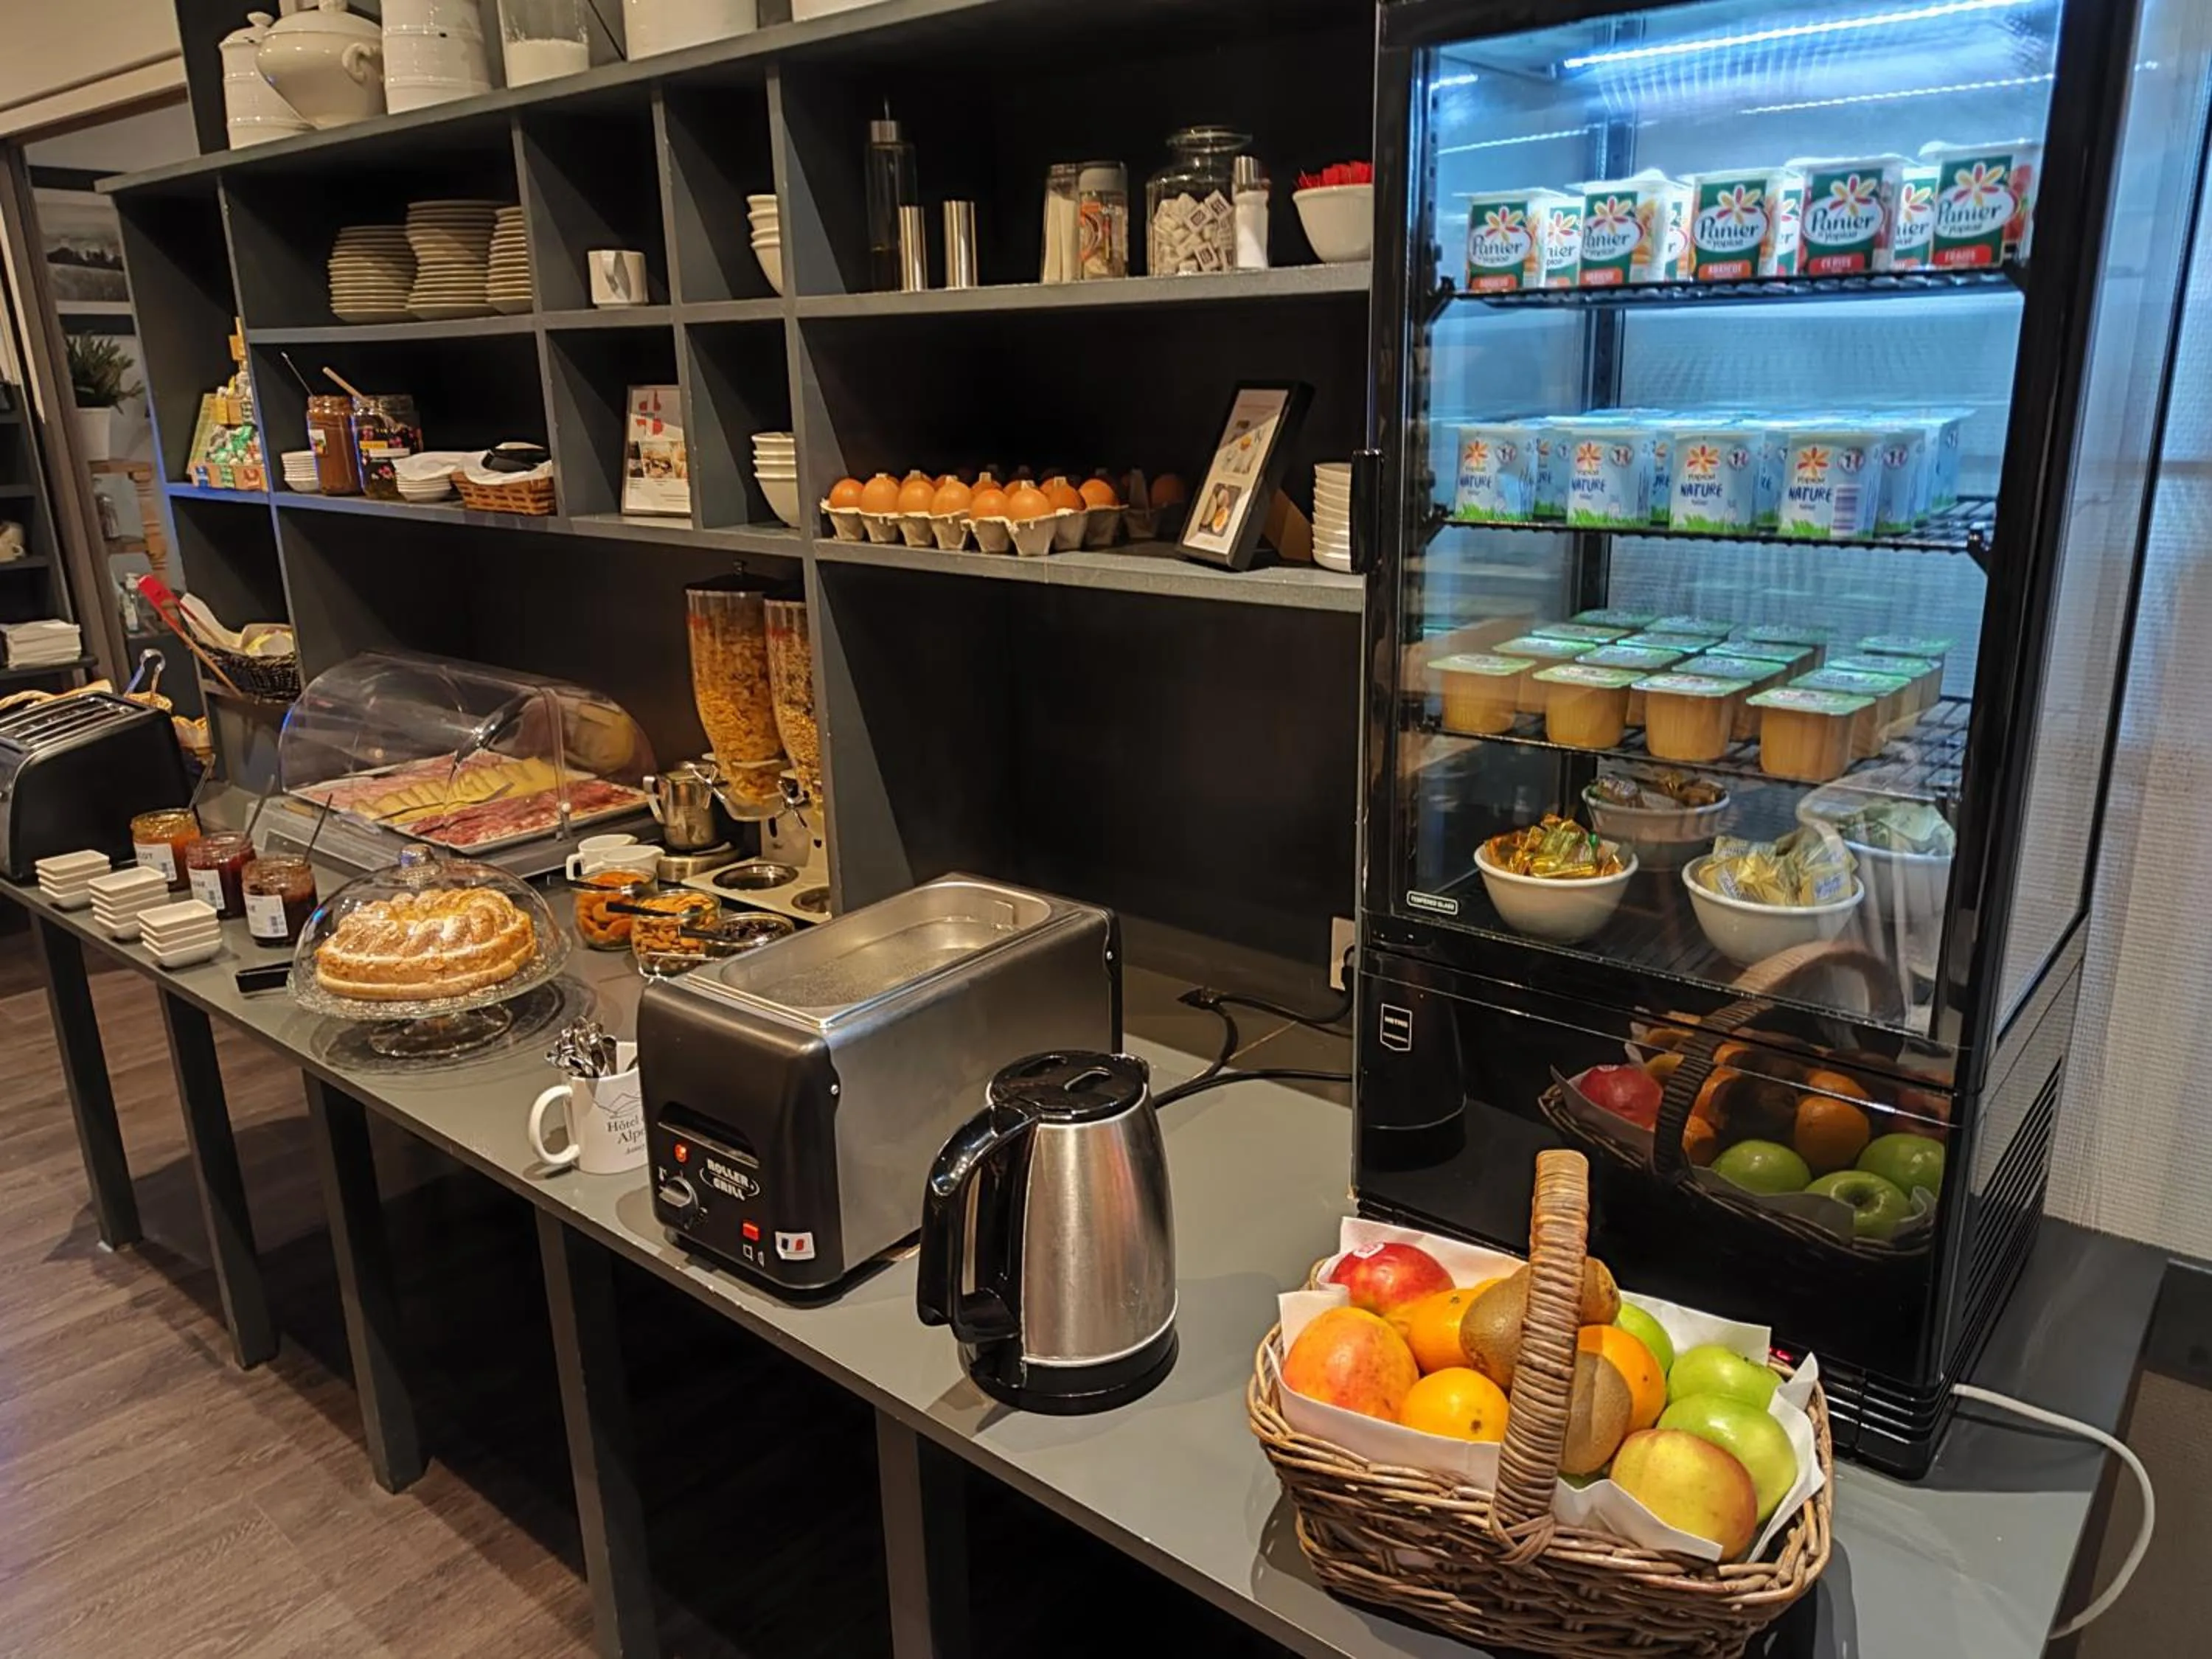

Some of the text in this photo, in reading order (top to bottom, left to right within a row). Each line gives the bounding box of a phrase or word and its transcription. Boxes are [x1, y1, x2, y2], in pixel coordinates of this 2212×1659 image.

[1812, 207, 1875, 233] Panier
[1937, 201, 2003, 226] Panier
[1700, 215, 1760, 240] Panier
[1896, 222, 1930, 237] nier
[1585, 226, 1631, 249] Panier
[1547, 246, 1576, 257] nier
[1460, 474, 1492, 488] NATURE
[1572, 478, 1605, 493] NATURE
[1680, 482, 1723, 498] NATURE
[1789, 485, 1833, 503] NATURE
[608, 1115, 639, 1133] Hôtel
[706, 1158, 749, 1188] ROLLER
[713, 1178, 745, 1201] GRILL
